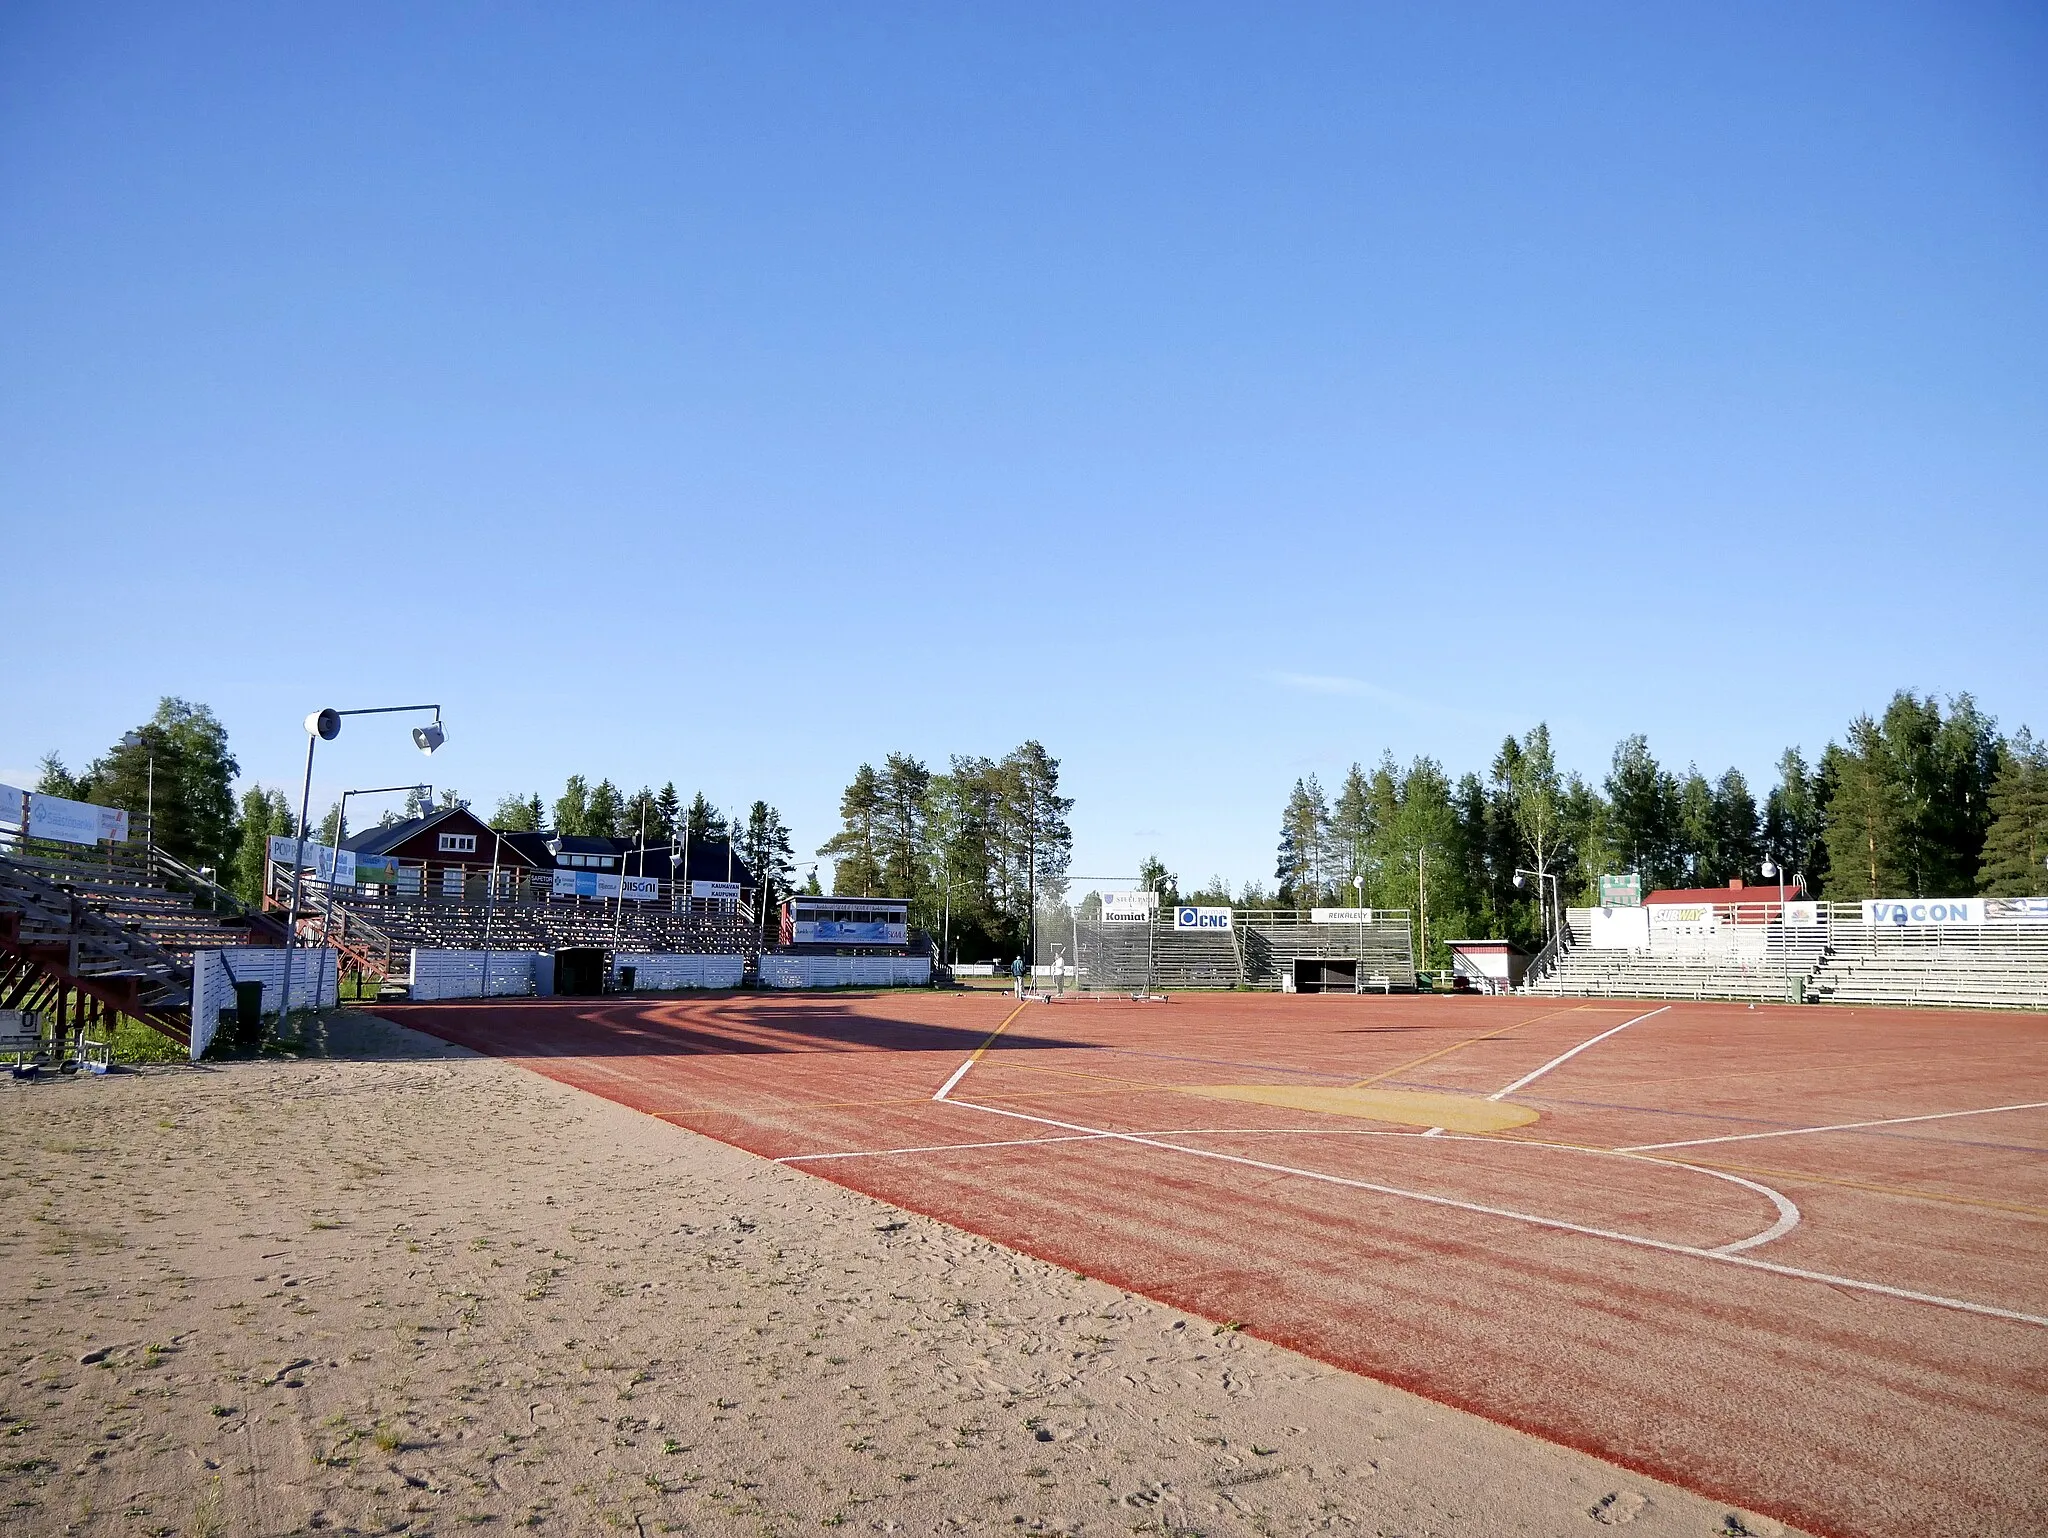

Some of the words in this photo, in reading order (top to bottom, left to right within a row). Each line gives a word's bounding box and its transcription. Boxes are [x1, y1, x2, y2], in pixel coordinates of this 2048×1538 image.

[1105, 912, 1145, 921] Komiat
[1655, 908, 1706, 922] SUBWAY
[1871, 904, 1968, 921] VACON
[1198, 915, 1228, 928] CNC
